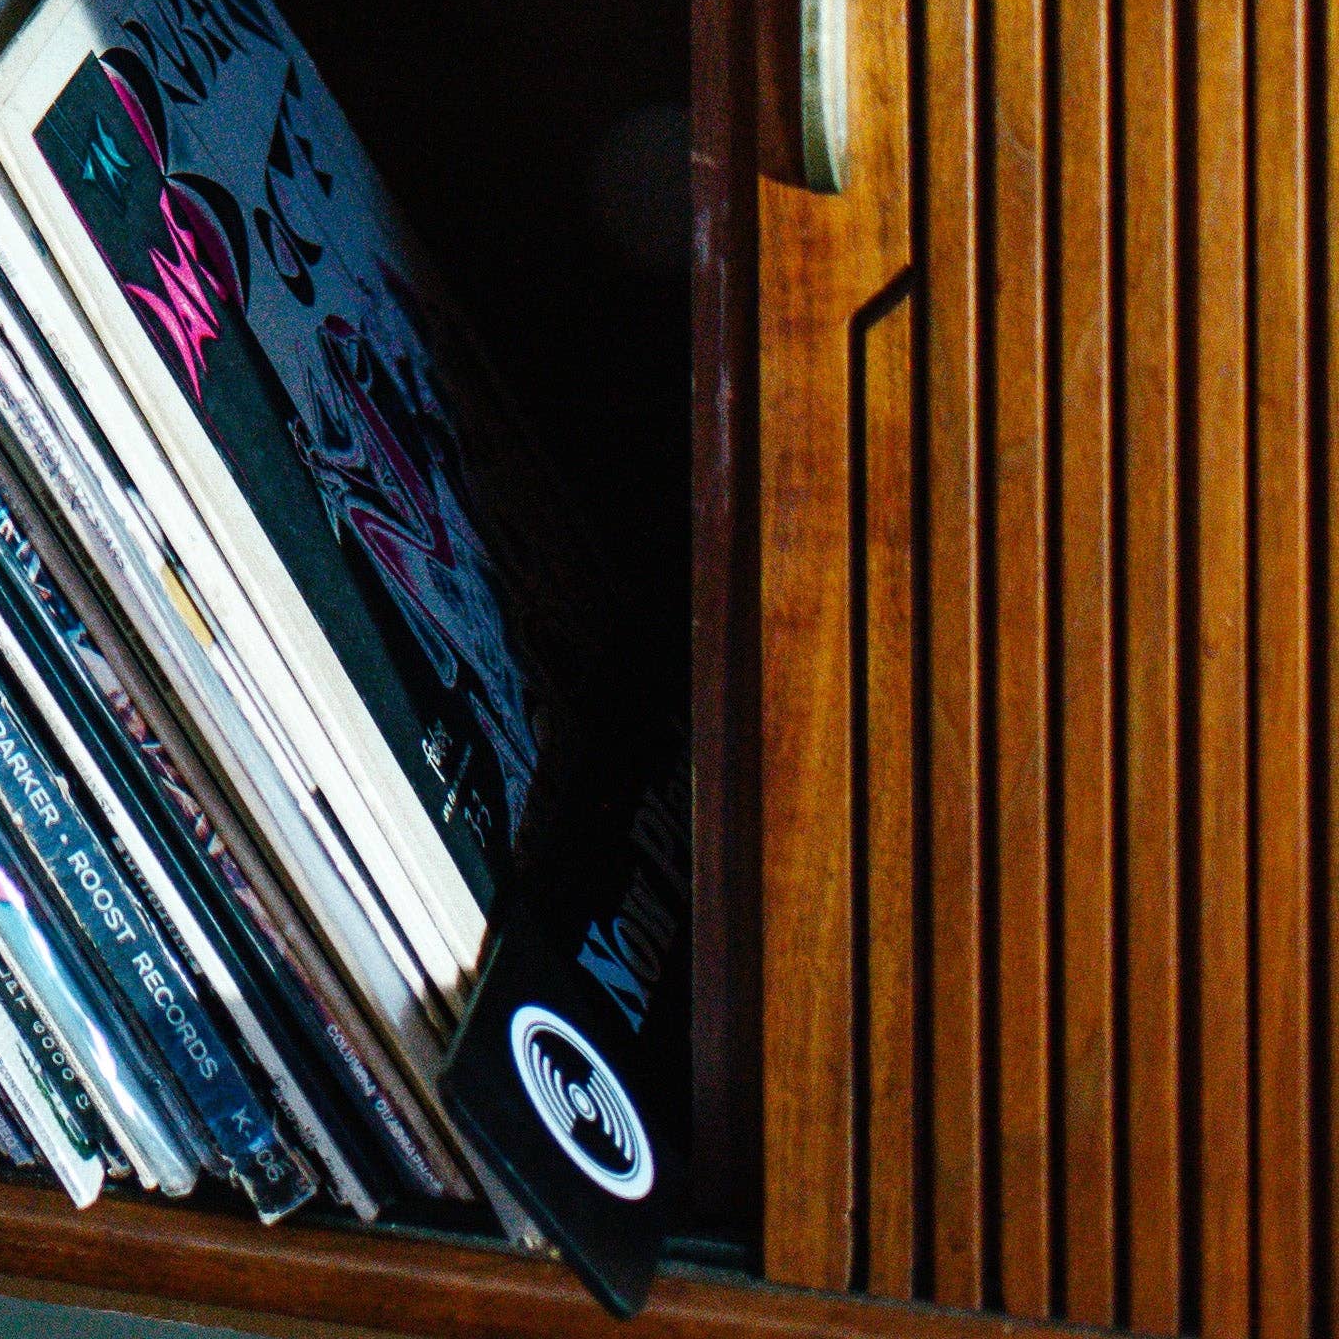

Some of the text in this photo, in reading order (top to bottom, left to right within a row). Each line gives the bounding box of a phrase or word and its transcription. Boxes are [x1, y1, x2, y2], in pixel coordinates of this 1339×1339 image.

[44, 330, 89, 394] EUROPE
[12, 415, 34, 441] TO
[89, 515, 129, 571] STARS
[65, 848, 222, 1083] ROOST RECORDS
